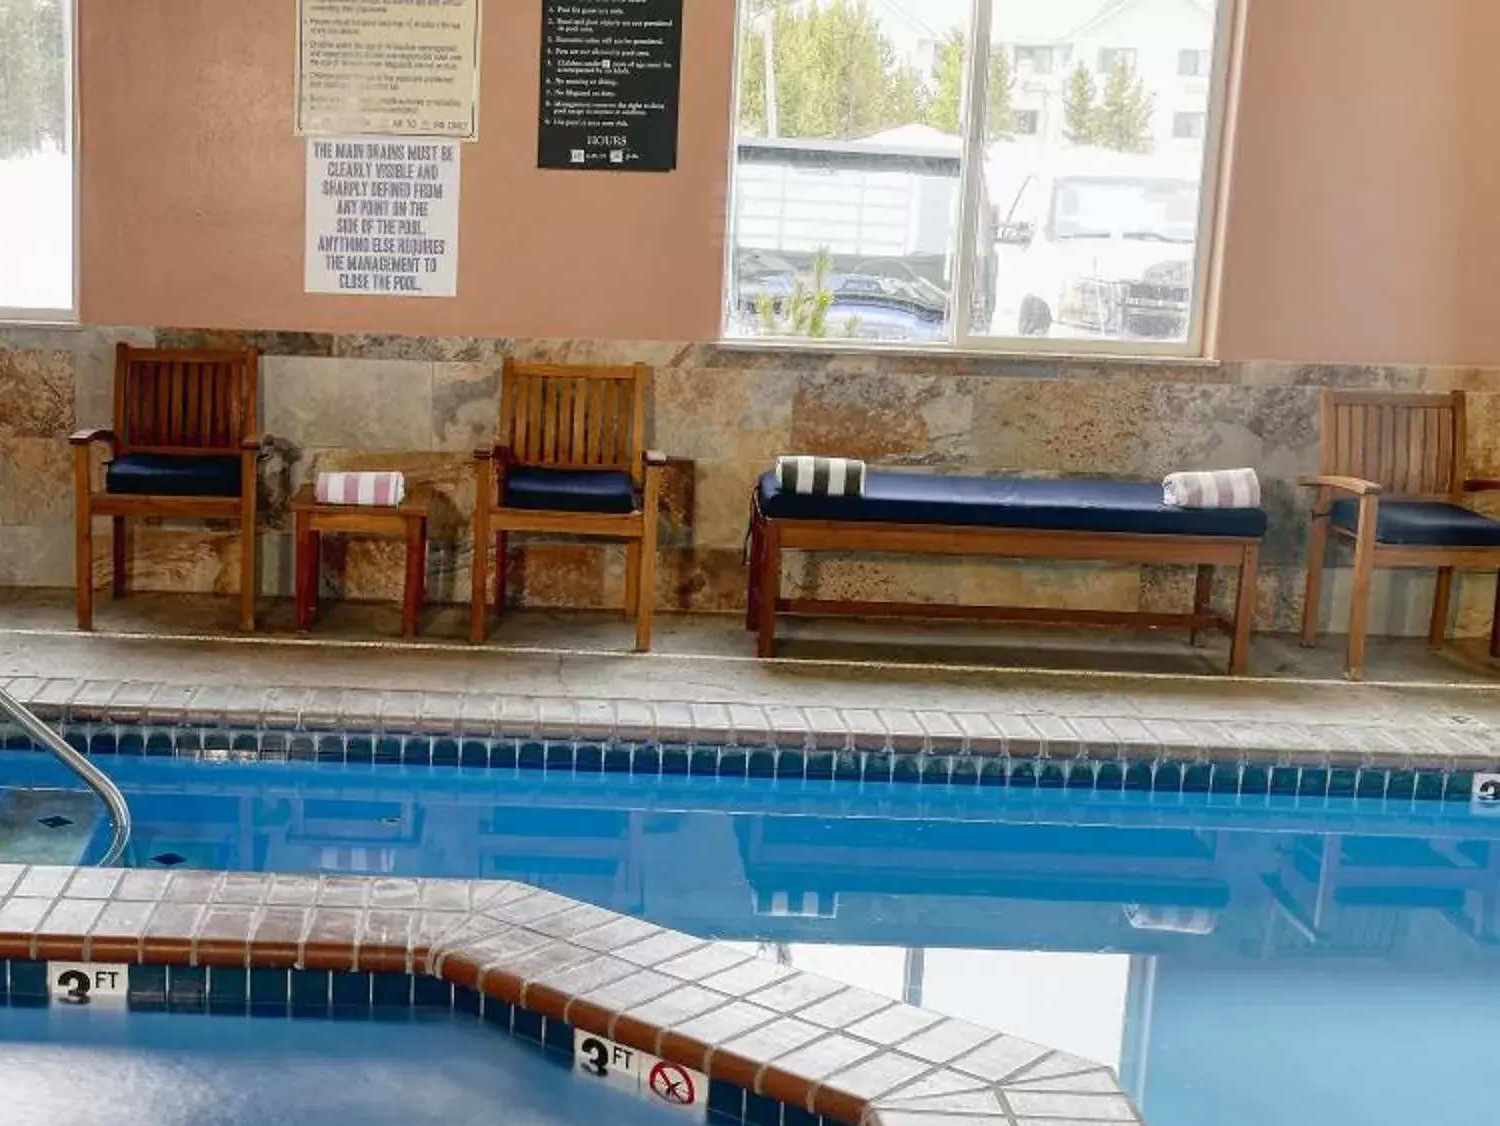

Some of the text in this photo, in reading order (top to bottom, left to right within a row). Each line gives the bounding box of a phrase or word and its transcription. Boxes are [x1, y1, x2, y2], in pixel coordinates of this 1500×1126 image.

[587, 136, 627, 144] HOURS
[314, 143, 454, 161] THE MAIN DRAINS MUST BE
[327, 163, 438, 180] CLEARLY VISIBLE AND
[322, 180, 443, 199] SHARPLY DEFINED FROM
[336, 200, 428, 216] ANY POINT ON THE
[336, 219, 426, 235] SIDE OF THE POOL.
[318, 236, 445, 255] ANYTHING ELSE REQUIRES
[326, 255, 437, 272] THE MANAGEMENT TO
[339, 274, 421, 290] CLOSE THE POOL.
[57, 969, 119, 1004] 3 FT
[581, 1037, 635, 1075] 3 FT
